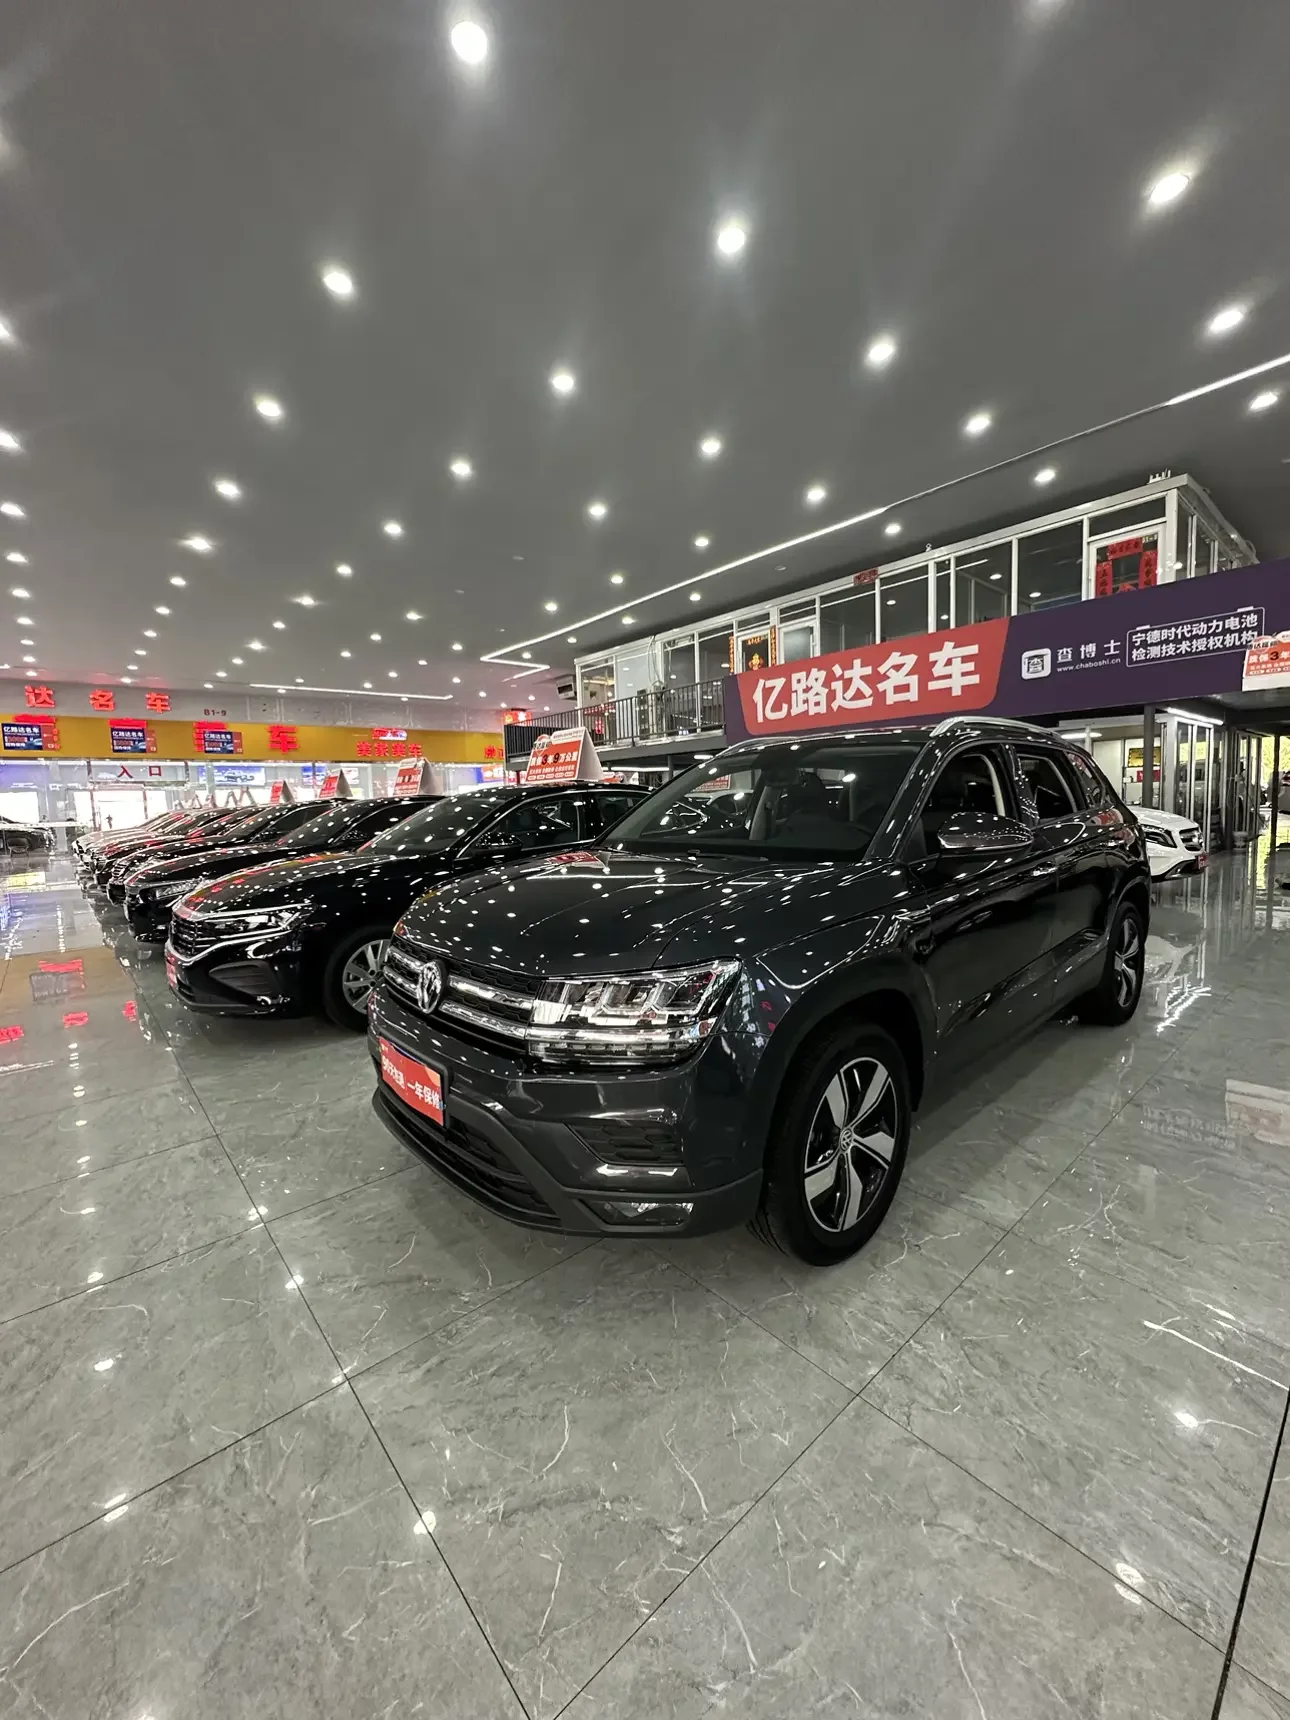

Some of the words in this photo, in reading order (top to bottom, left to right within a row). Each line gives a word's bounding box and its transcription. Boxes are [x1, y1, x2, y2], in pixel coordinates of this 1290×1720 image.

[1131, 612, 1258, 647] 宁德时代动力电池
[1057, 639, 1121, 663] 查博士
[1131, 630, 1258, 661] 检测技术授权机构
[1057, 657, 1121, 673] www.chaboshi.cn
[752, 641, 981, 723] 亿路达名车
[203, 708, 227, 717] B1-9
[117, 765, 162, 779] 入口
